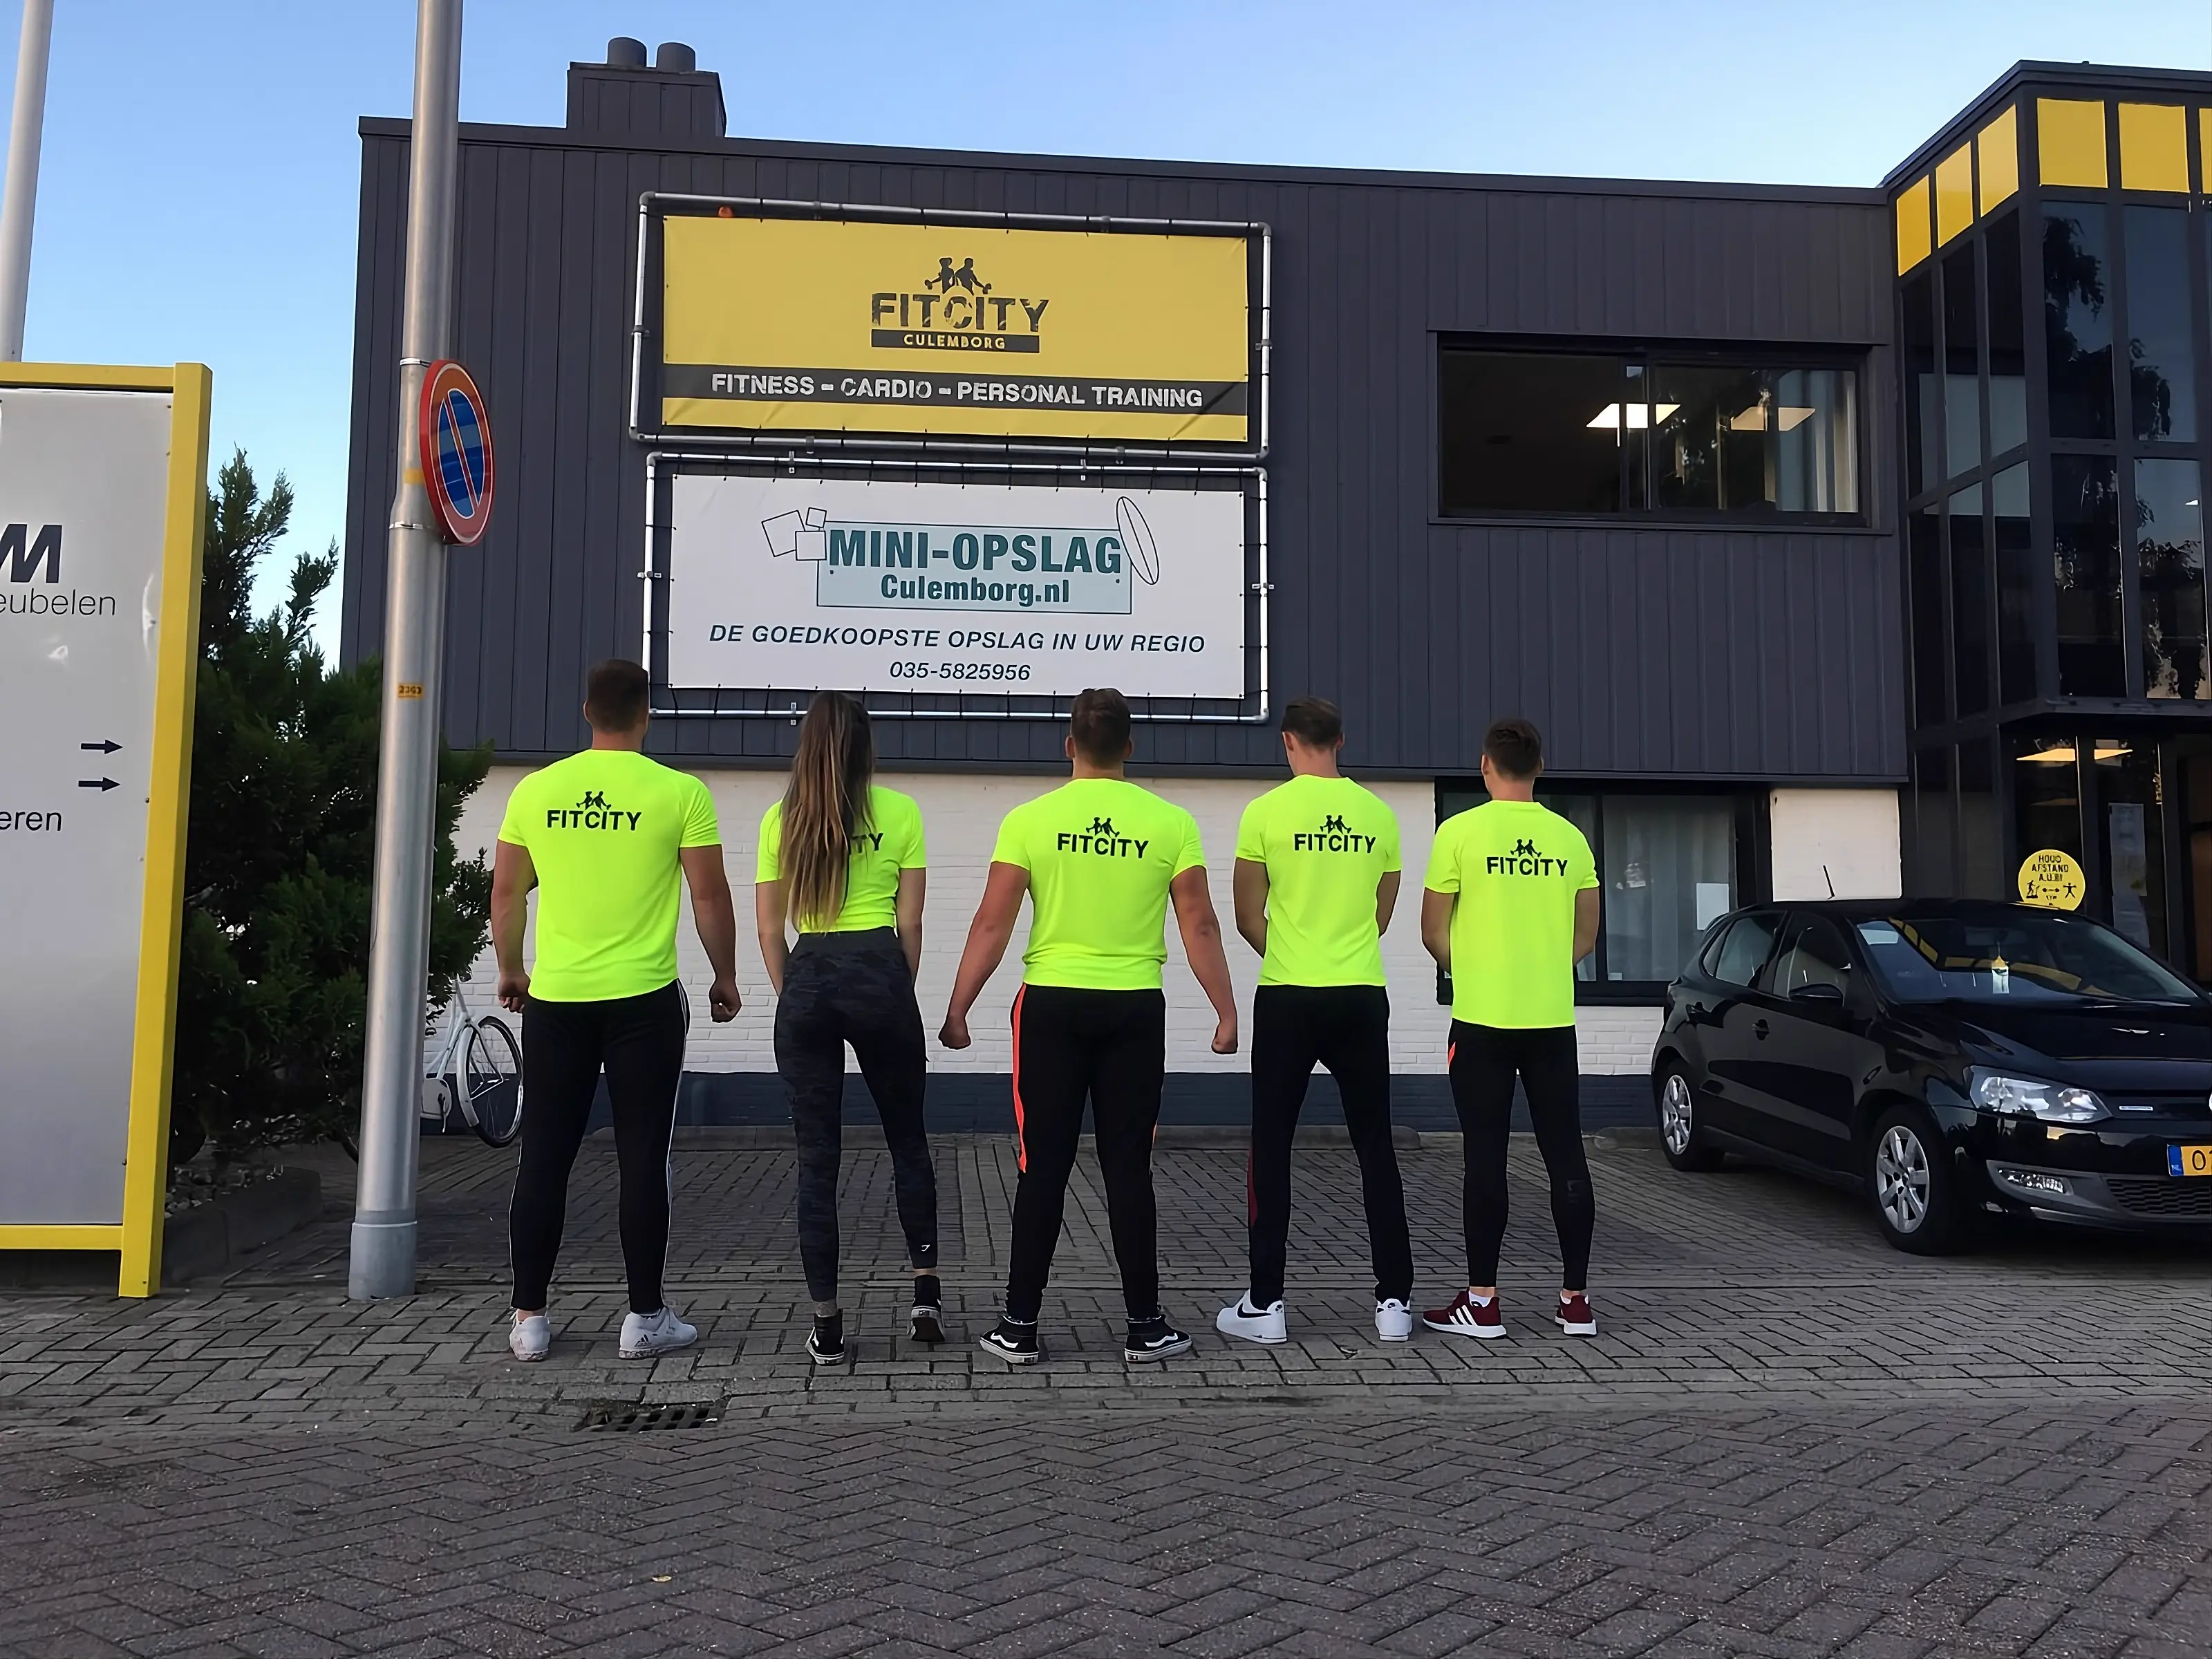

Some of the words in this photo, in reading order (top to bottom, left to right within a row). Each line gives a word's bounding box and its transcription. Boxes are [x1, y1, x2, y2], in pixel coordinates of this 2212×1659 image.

[872, 292, 1049, 332] FITCITY
[903, 334, 1005, 349] CULEMBORG
[712, 373, 815, 395] FITNESS
[841, 377, 932, 399] CARDIO
[957, 382, 1085, 404] PERSONAL
[1091, 386, 1203, 408] TRAINING
[830, 529, 1121, 574] MINI-OPSLAG
[881, 574, 1069, 607] Culemborg.nl
[709, 624, 744, 642] DE
[752, 626, 940, 648] GOEDKOOPSTE
[948, 630, 1044, 650] OPSLAG
[1052, 633, 1077, 650] IN
[1085, 633, 1124, 652] UW
[1130, 635, 1205, 653] REGIO
[890, 662, 1031, 682] 035-5825956
[547, 809, 642, 832] FITCITY
[1057, 832, 1150, 859] FITCITY
[1293, 833, 1376, 854] FITCITY
[1486, 856, 1568, 877] FITCITY
